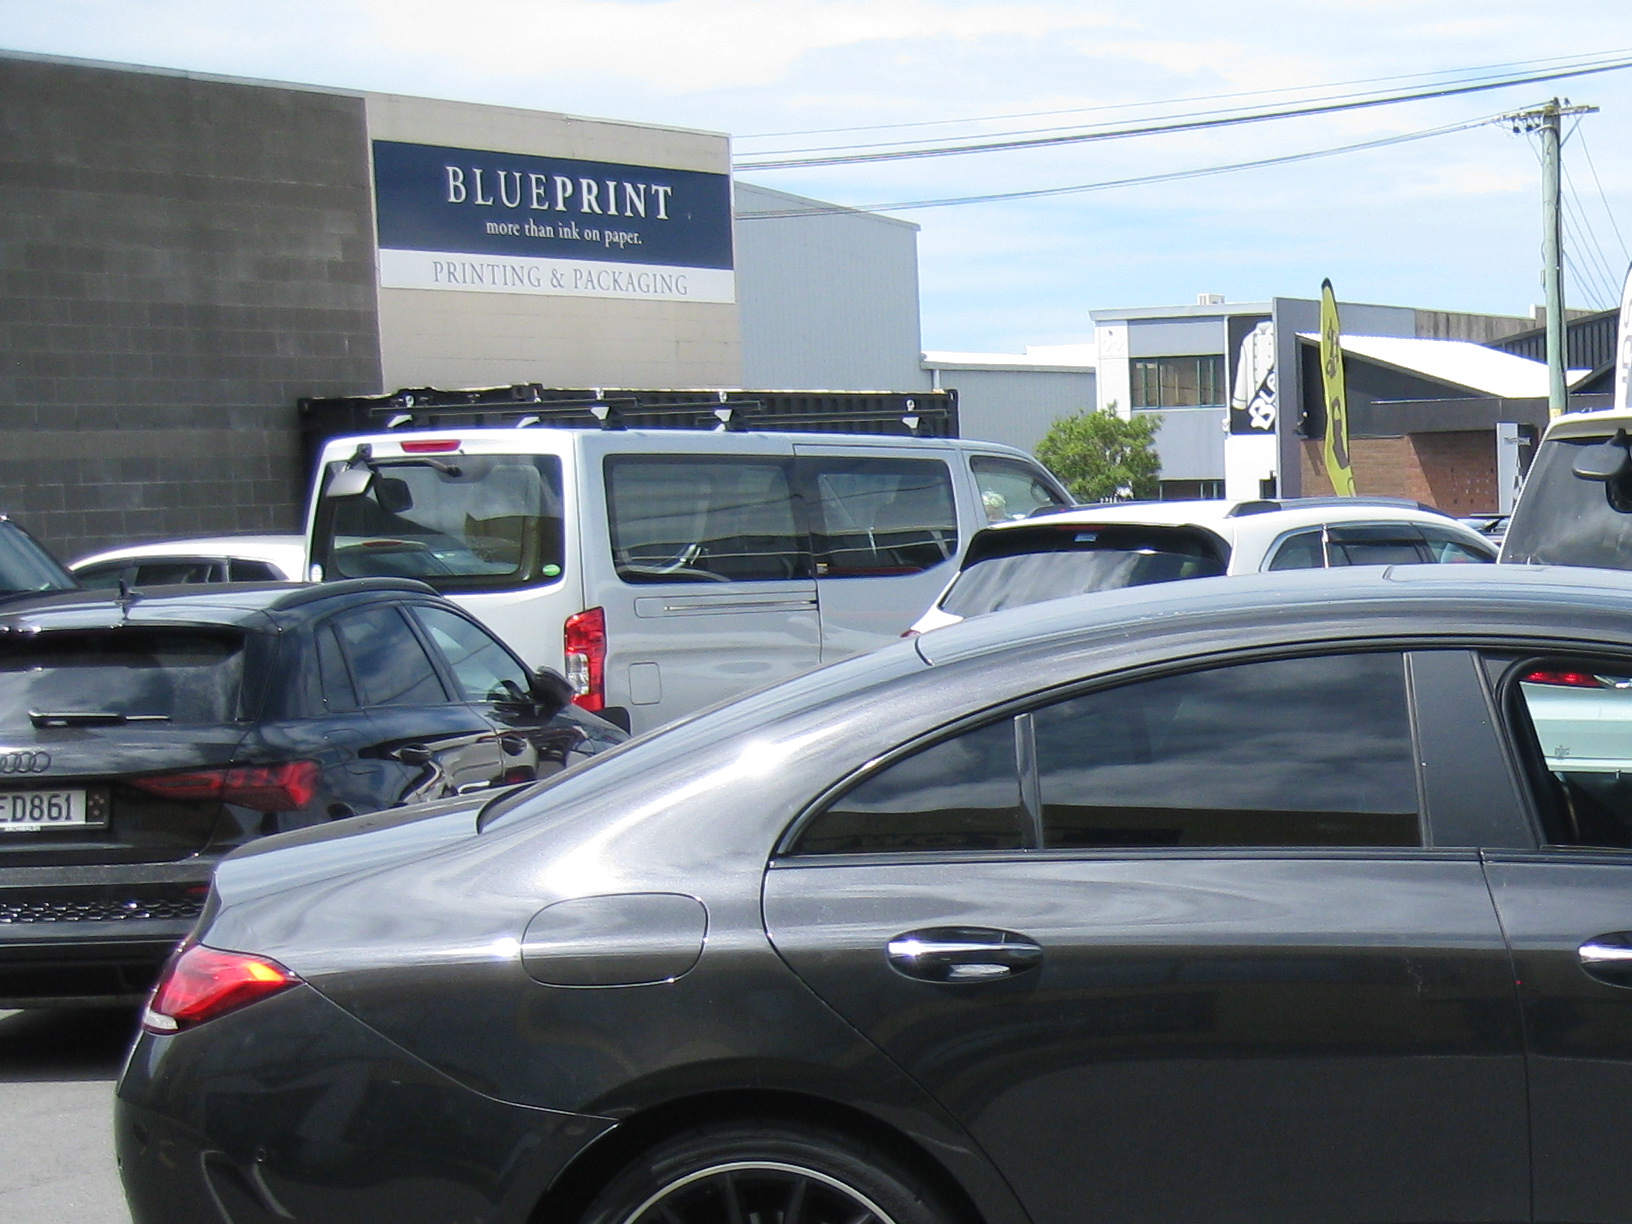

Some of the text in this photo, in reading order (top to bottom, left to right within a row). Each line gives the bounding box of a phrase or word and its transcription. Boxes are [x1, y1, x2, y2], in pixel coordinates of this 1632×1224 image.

[445, 165, 673, 220] BLUEPRINT
[486, 218, 642, 249] more than ink on paper.
[432, 260, 689, 295] PRINTING & PACKAGING
